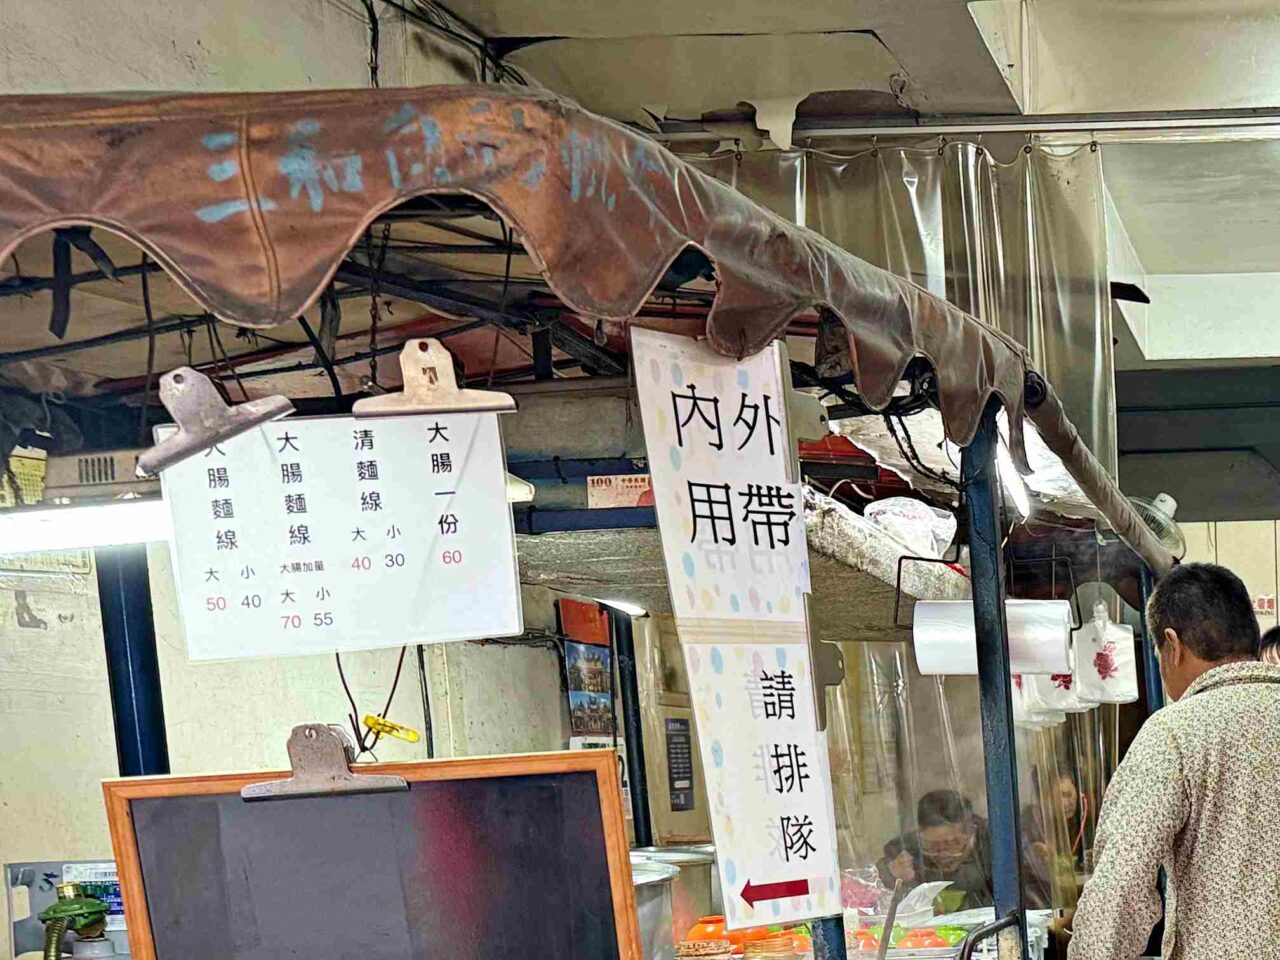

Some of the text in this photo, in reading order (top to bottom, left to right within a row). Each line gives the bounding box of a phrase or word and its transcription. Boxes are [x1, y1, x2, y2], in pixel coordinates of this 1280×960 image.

[353, 429, 383, 512] 清麵線
[671, 384, 737, 546] 內用
[733, 392, 796, 550] 外帶
[427, 422, 460, 535] 大腸一份
[589, 478, 612, 487] 100
[276, 431, 312, 546] 大腸麵線
[351, 525, 402, 542] 大 小
[351, 553, 406, 571] 40 30
[442, 550, 462, 565] 60
[204, 566, 256, 582] 大 小
[206, 594, 262, 612] 50 40
[280, 587, 331, 604] 大 小
[280, 612, 334, 630] 70 55
[760, 669, 817, 863] 請排隊
